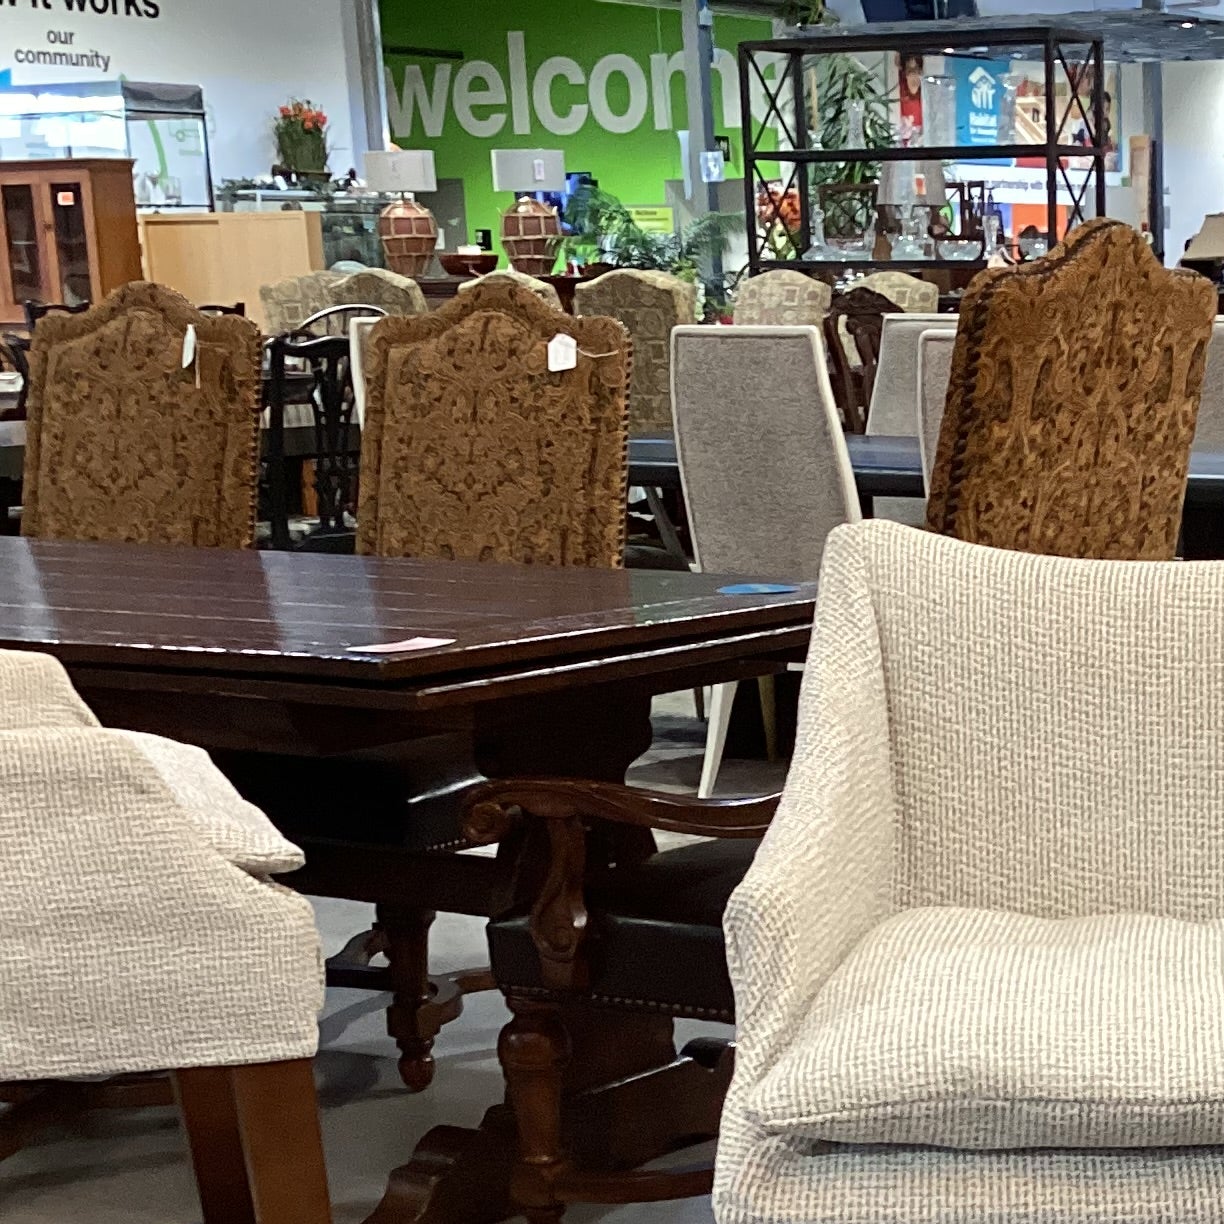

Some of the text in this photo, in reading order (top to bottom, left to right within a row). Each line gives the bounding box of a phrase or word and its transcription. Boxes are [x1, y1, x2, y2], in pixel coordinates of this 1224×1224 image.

[64, 0, 160, 18] works
[46, 29, 75, 45] our
[14, 48, 111, 73] community
